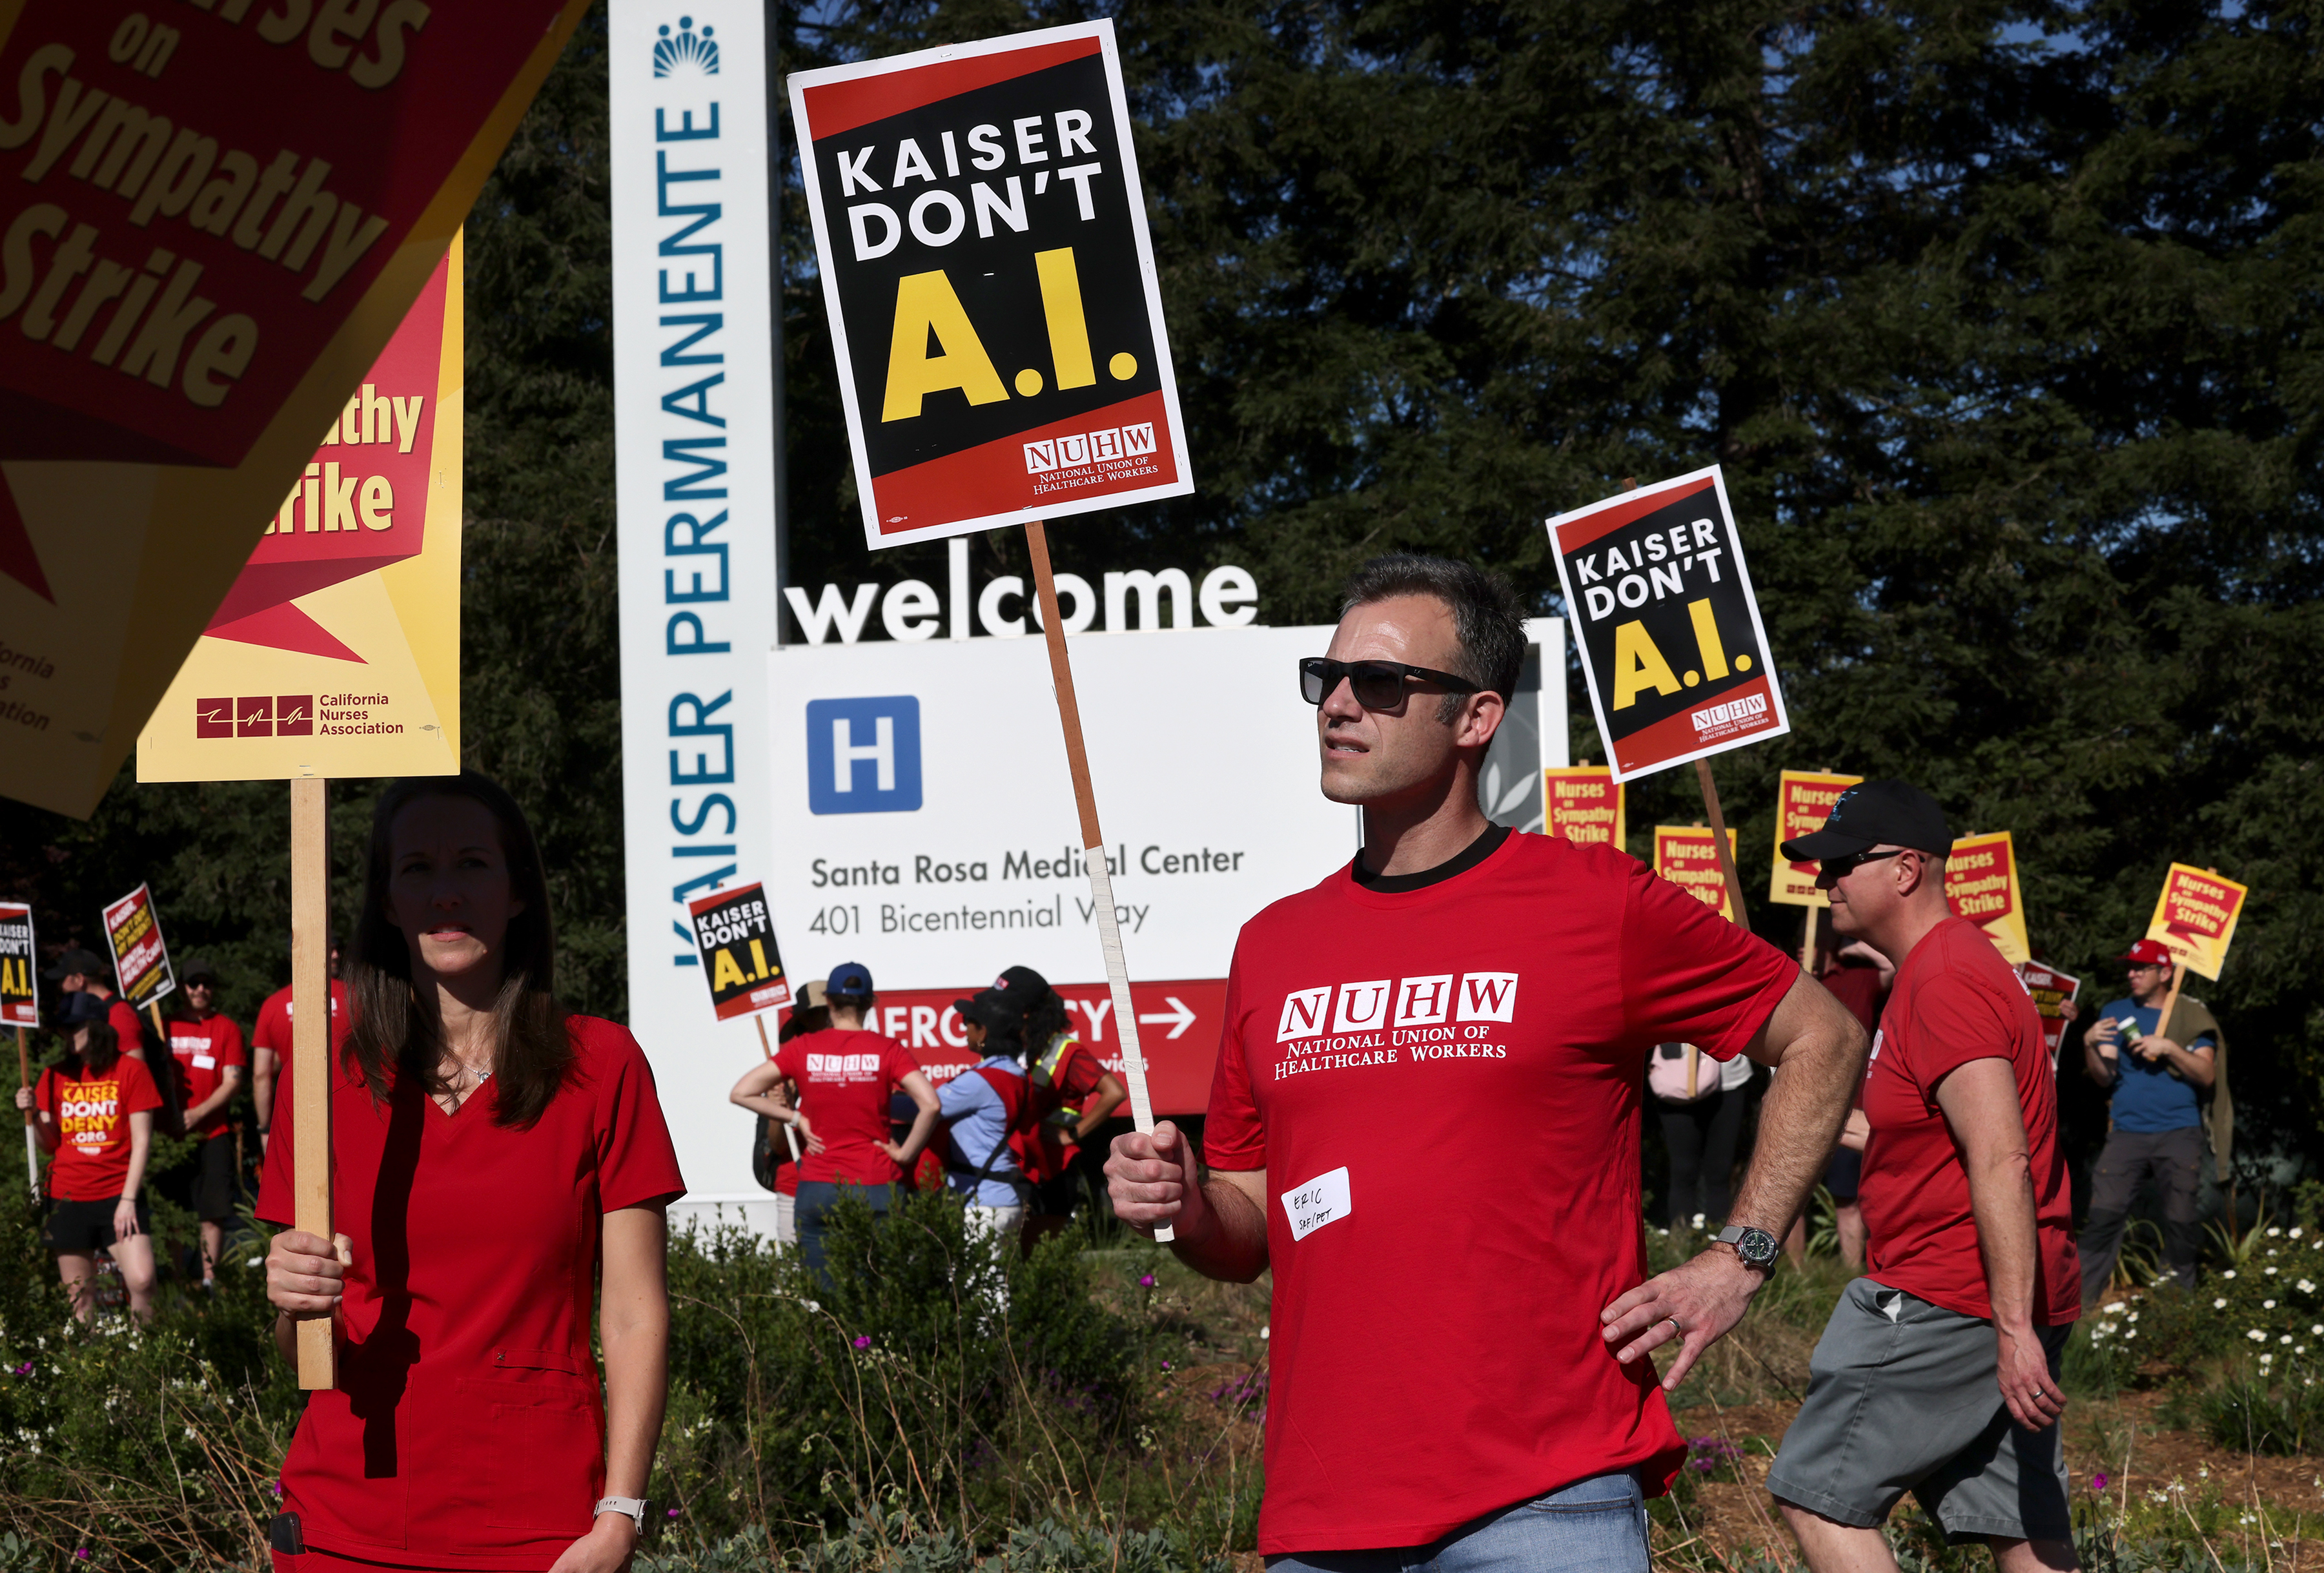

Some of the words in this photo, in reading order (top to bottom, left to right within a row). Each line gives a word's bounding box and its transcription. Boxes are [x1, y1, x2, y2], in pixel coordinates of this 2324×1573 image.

[108, 13, 181, 78] on
[837, 109, 1098, 197] KAISER
[0, 43, 389, 303] Sympathy
[847, 164, 1102, 262] DON'T
[0, 203, 259, 407] Strike
[881, 246, 1138, 423] A.I.
[654, 101, 732, 655] PERMANENTE
[1026, 424, 1152, 471] NUHW
[1033, 475, 1105, 495] HEALTHCARE
[1106, 465, 1159, 482] WORKERS
[1039, 466, 1095, 484] NATIONAL
[1097, 459, 1133, 474] UNION
[1134, 456, 1149, 466] OF
[263, 462, 394, 534] rike
[1576, 518, 1718, 585] KAISER
[783, 537, 1259, 644] welcome
[1584, 548, 1722, 621] DON'T
[0, 641, 55, 679] ornia
[1613, 597, 1752, 711] A.I.
[320, 693, 389, 707] California
[320, 708, 369, 721] Nurses
[1693, 694, 1766, 730] NUHW
[320, 722, 403, 735] Association
[831, 715, 896, 794] H
[1555, 780, 1605, 798] Nurses
[1553, 805, 1616, 825] Sympathy
[1786, 811, 1828, 832] Symp
[1564, 824, 1609, 843] Strike
[1666, 840, 1717, 859] Nurses
[811, 858, 901, 888] Santa
[914, 855, 988, 883] Rosa
[1139, 845, 1245, 875] Center
[1663, 866, 1724, 887] Sympathy
[1944, 851, 1995, 873] Nurses
[1677, 885, 1718, 905] ike
[1944, 874, 2008, 899] Sympathy
[2176, 874, 2226, 901] Nurses
[697, 900, 765, 932] KAISER
[808, 905, 861, 935] 401
[881, 893, 1062, 934] Bicentennial
[1959, 893, 2005, 916] Strike
[2168, 891, 2230, 923] Sympathy
[2174, 906, 2218, 934] Strike
[0, 938, 30, 955] DON'T
[700, 914, 766, 949] DON'T
[1, 957, 32, 996] A.I.
[713, 938, 780, 992] A.I.
[1278, 974, 1517, 1040] NUHW
[1286, 1033, 1385, 1060] NATIONAL
[1392, 1026, 1456, 1047] UNION
[1463, 1025, 1491, 1040] OF
[808, 1054, 879, 1071] NUHW
[1274, 1049, 1398, 1080] HEALTHCARE
[1409, 1044, 1507, 1062] WORKERS
[61, 1099, 118, 1118] DONT
[63, 1085, 118, 1104] KAISER
[61, 1115, 119, 1133] DENY
[71, 1131, 107, 1143] .ORG
[1294, 1188, 1322, 1209] ERIC
